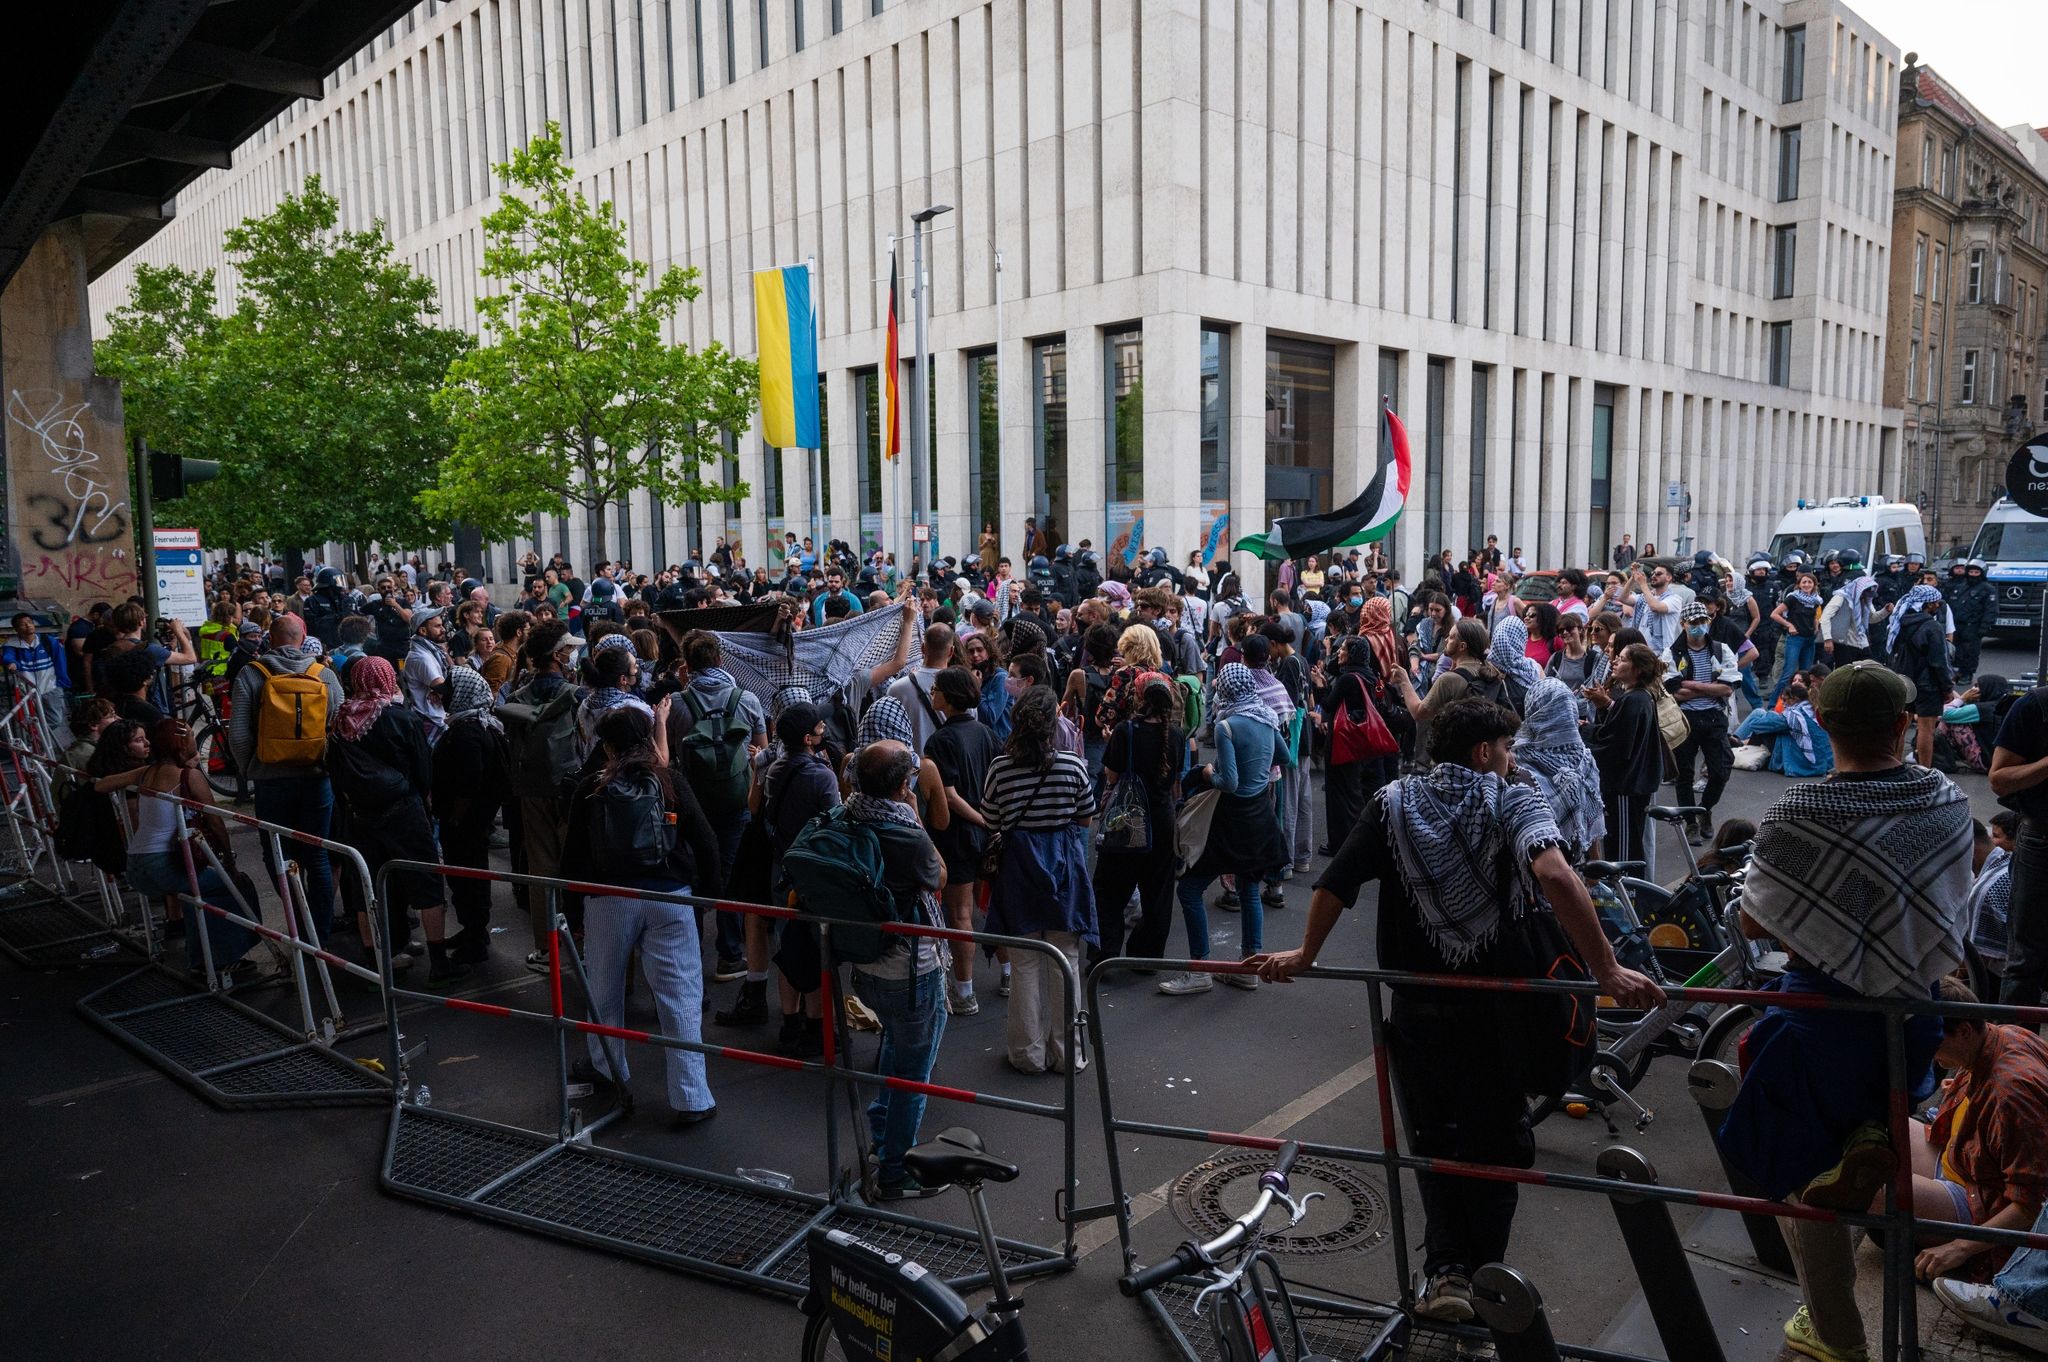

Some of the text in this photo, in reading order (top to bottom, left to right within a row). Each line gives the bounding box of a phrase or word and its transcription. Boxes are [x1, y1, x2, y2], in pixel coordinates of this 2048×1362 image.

[154, 535, 196, 543] Feuerwehrzufahrt
[584, 607, 608, 615] POLIZEI
[831, 1265, 897, 1315] Wir helfen bei
[831, 1286, 894, 1336] Radlosigkeit!
